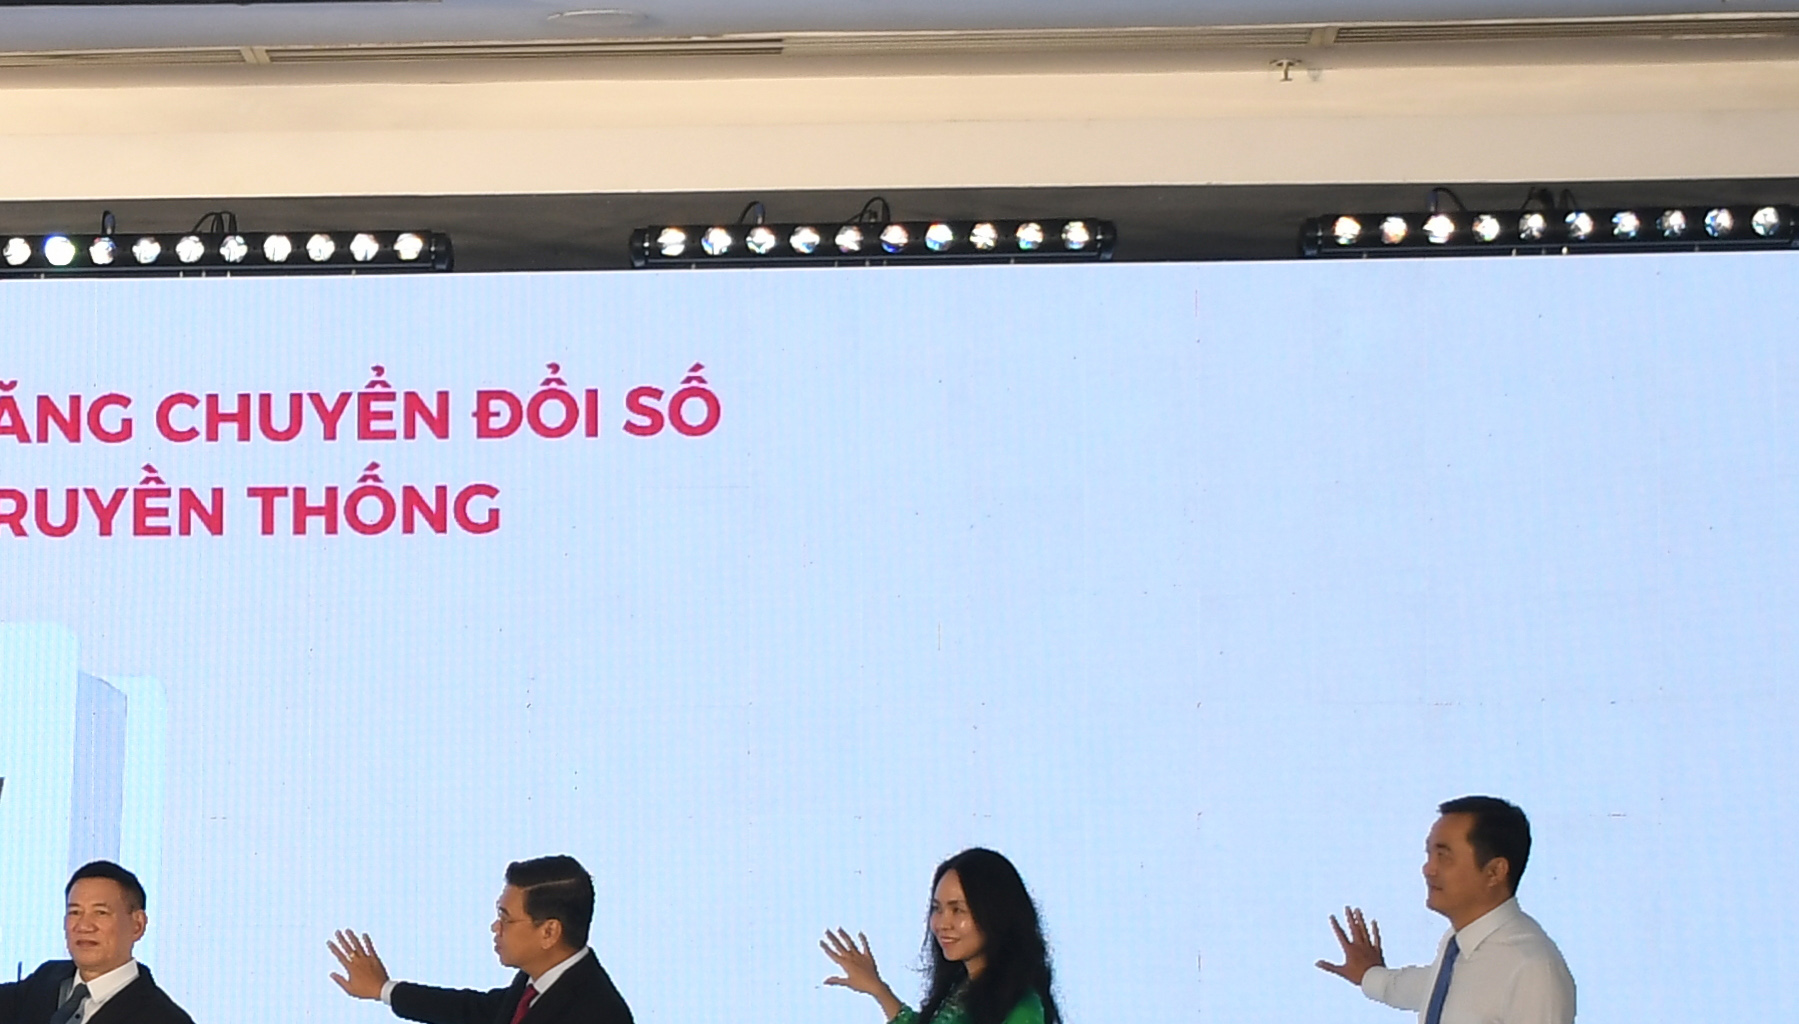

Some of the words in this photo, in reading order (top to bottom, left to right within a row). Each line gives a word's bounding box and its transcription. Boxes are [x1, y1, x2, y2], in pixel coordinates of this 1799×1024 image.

[155, 366, 450, 443] CHUYỂN
[473, 363, 600, 440] ĐỔI
[623, 364, 721, 438] SỐ
[247, 462, 501, 536] THỐNG
